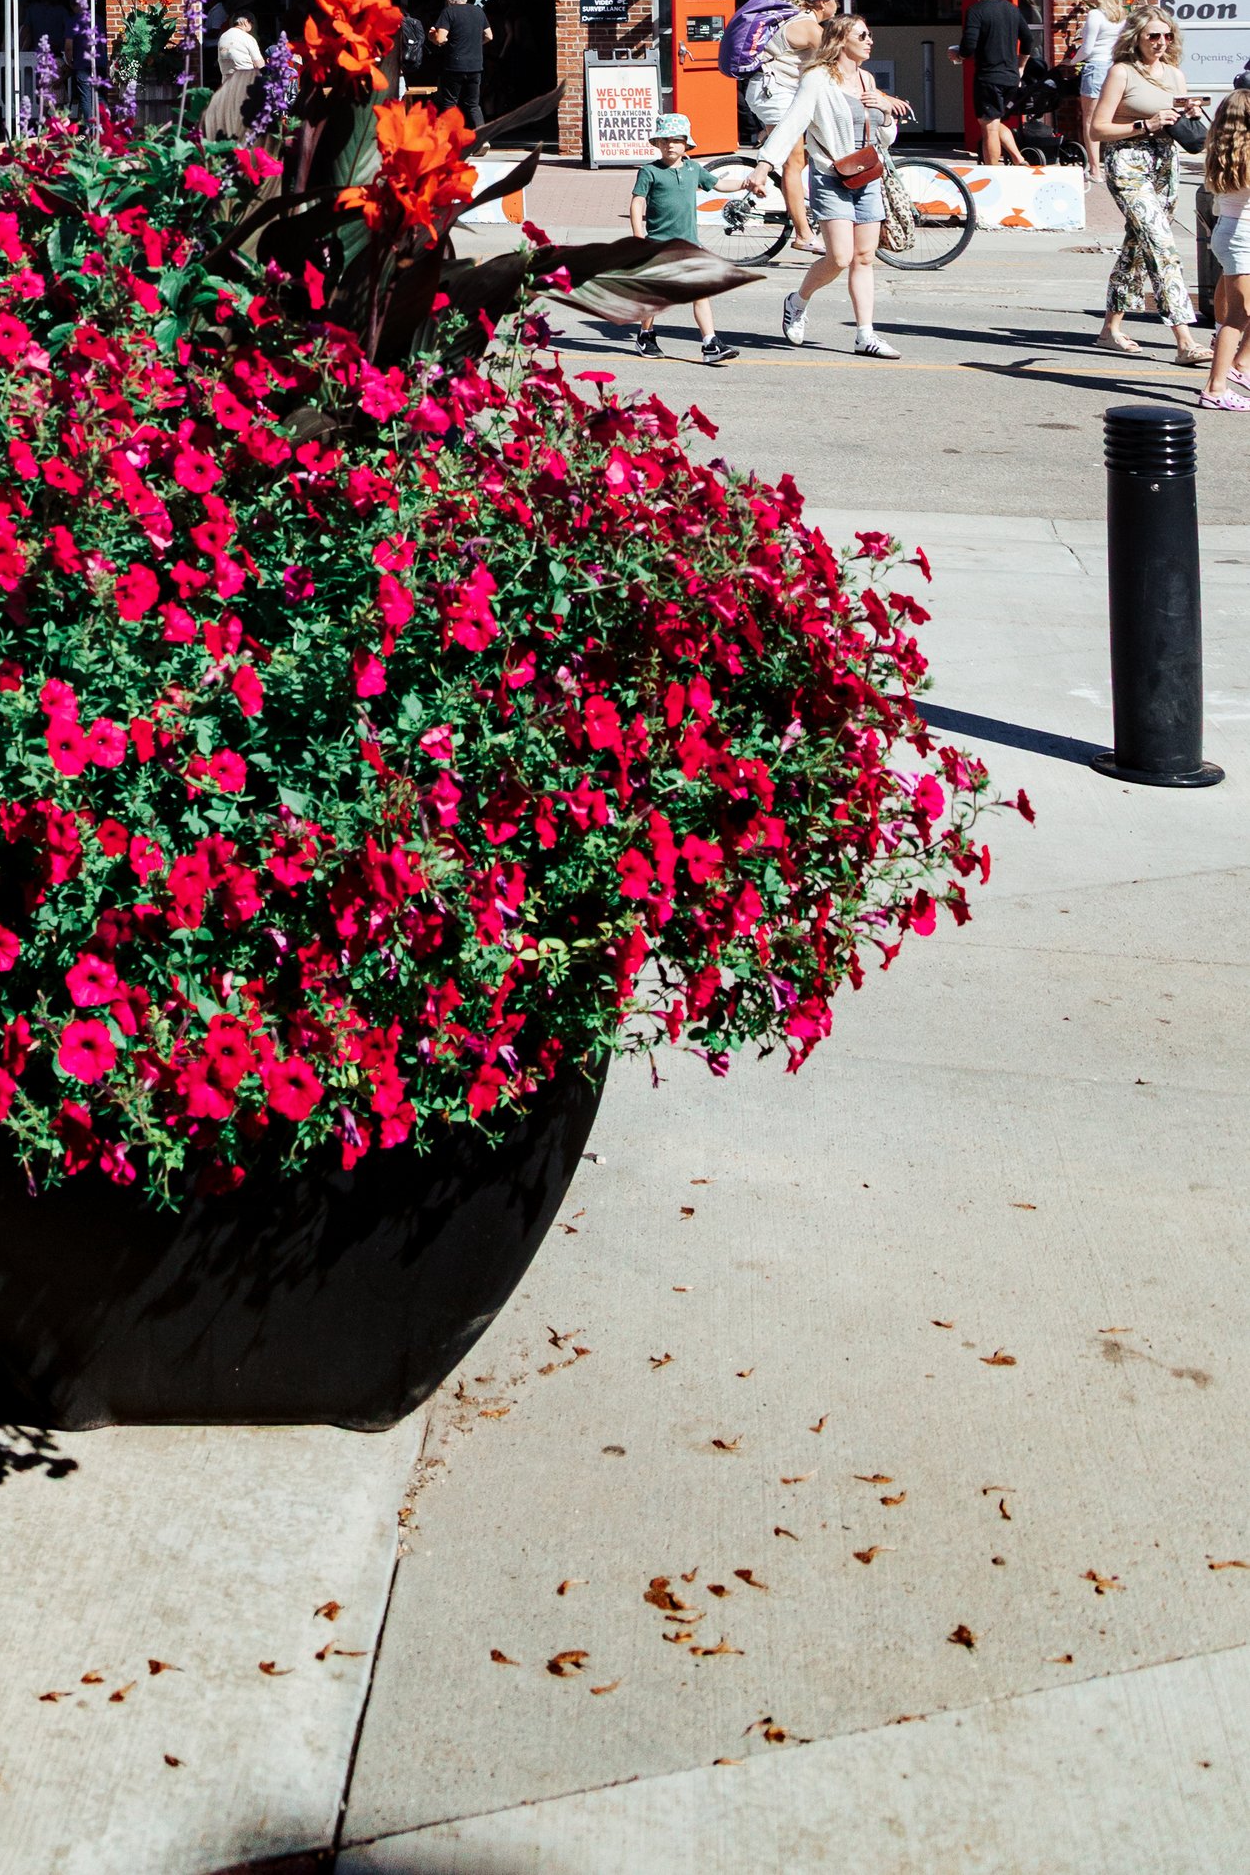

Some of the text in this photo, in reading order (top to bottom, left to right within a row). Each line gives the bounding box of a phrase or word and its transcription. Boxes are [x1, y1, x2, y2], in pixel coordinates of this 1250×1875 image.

[1191, 52, 1233, 64] Opening
[596, 87, 652, 97] WELCOME
[597, 97, 652, 109] TO THE
[598, 129, 652, 141] MARKET
